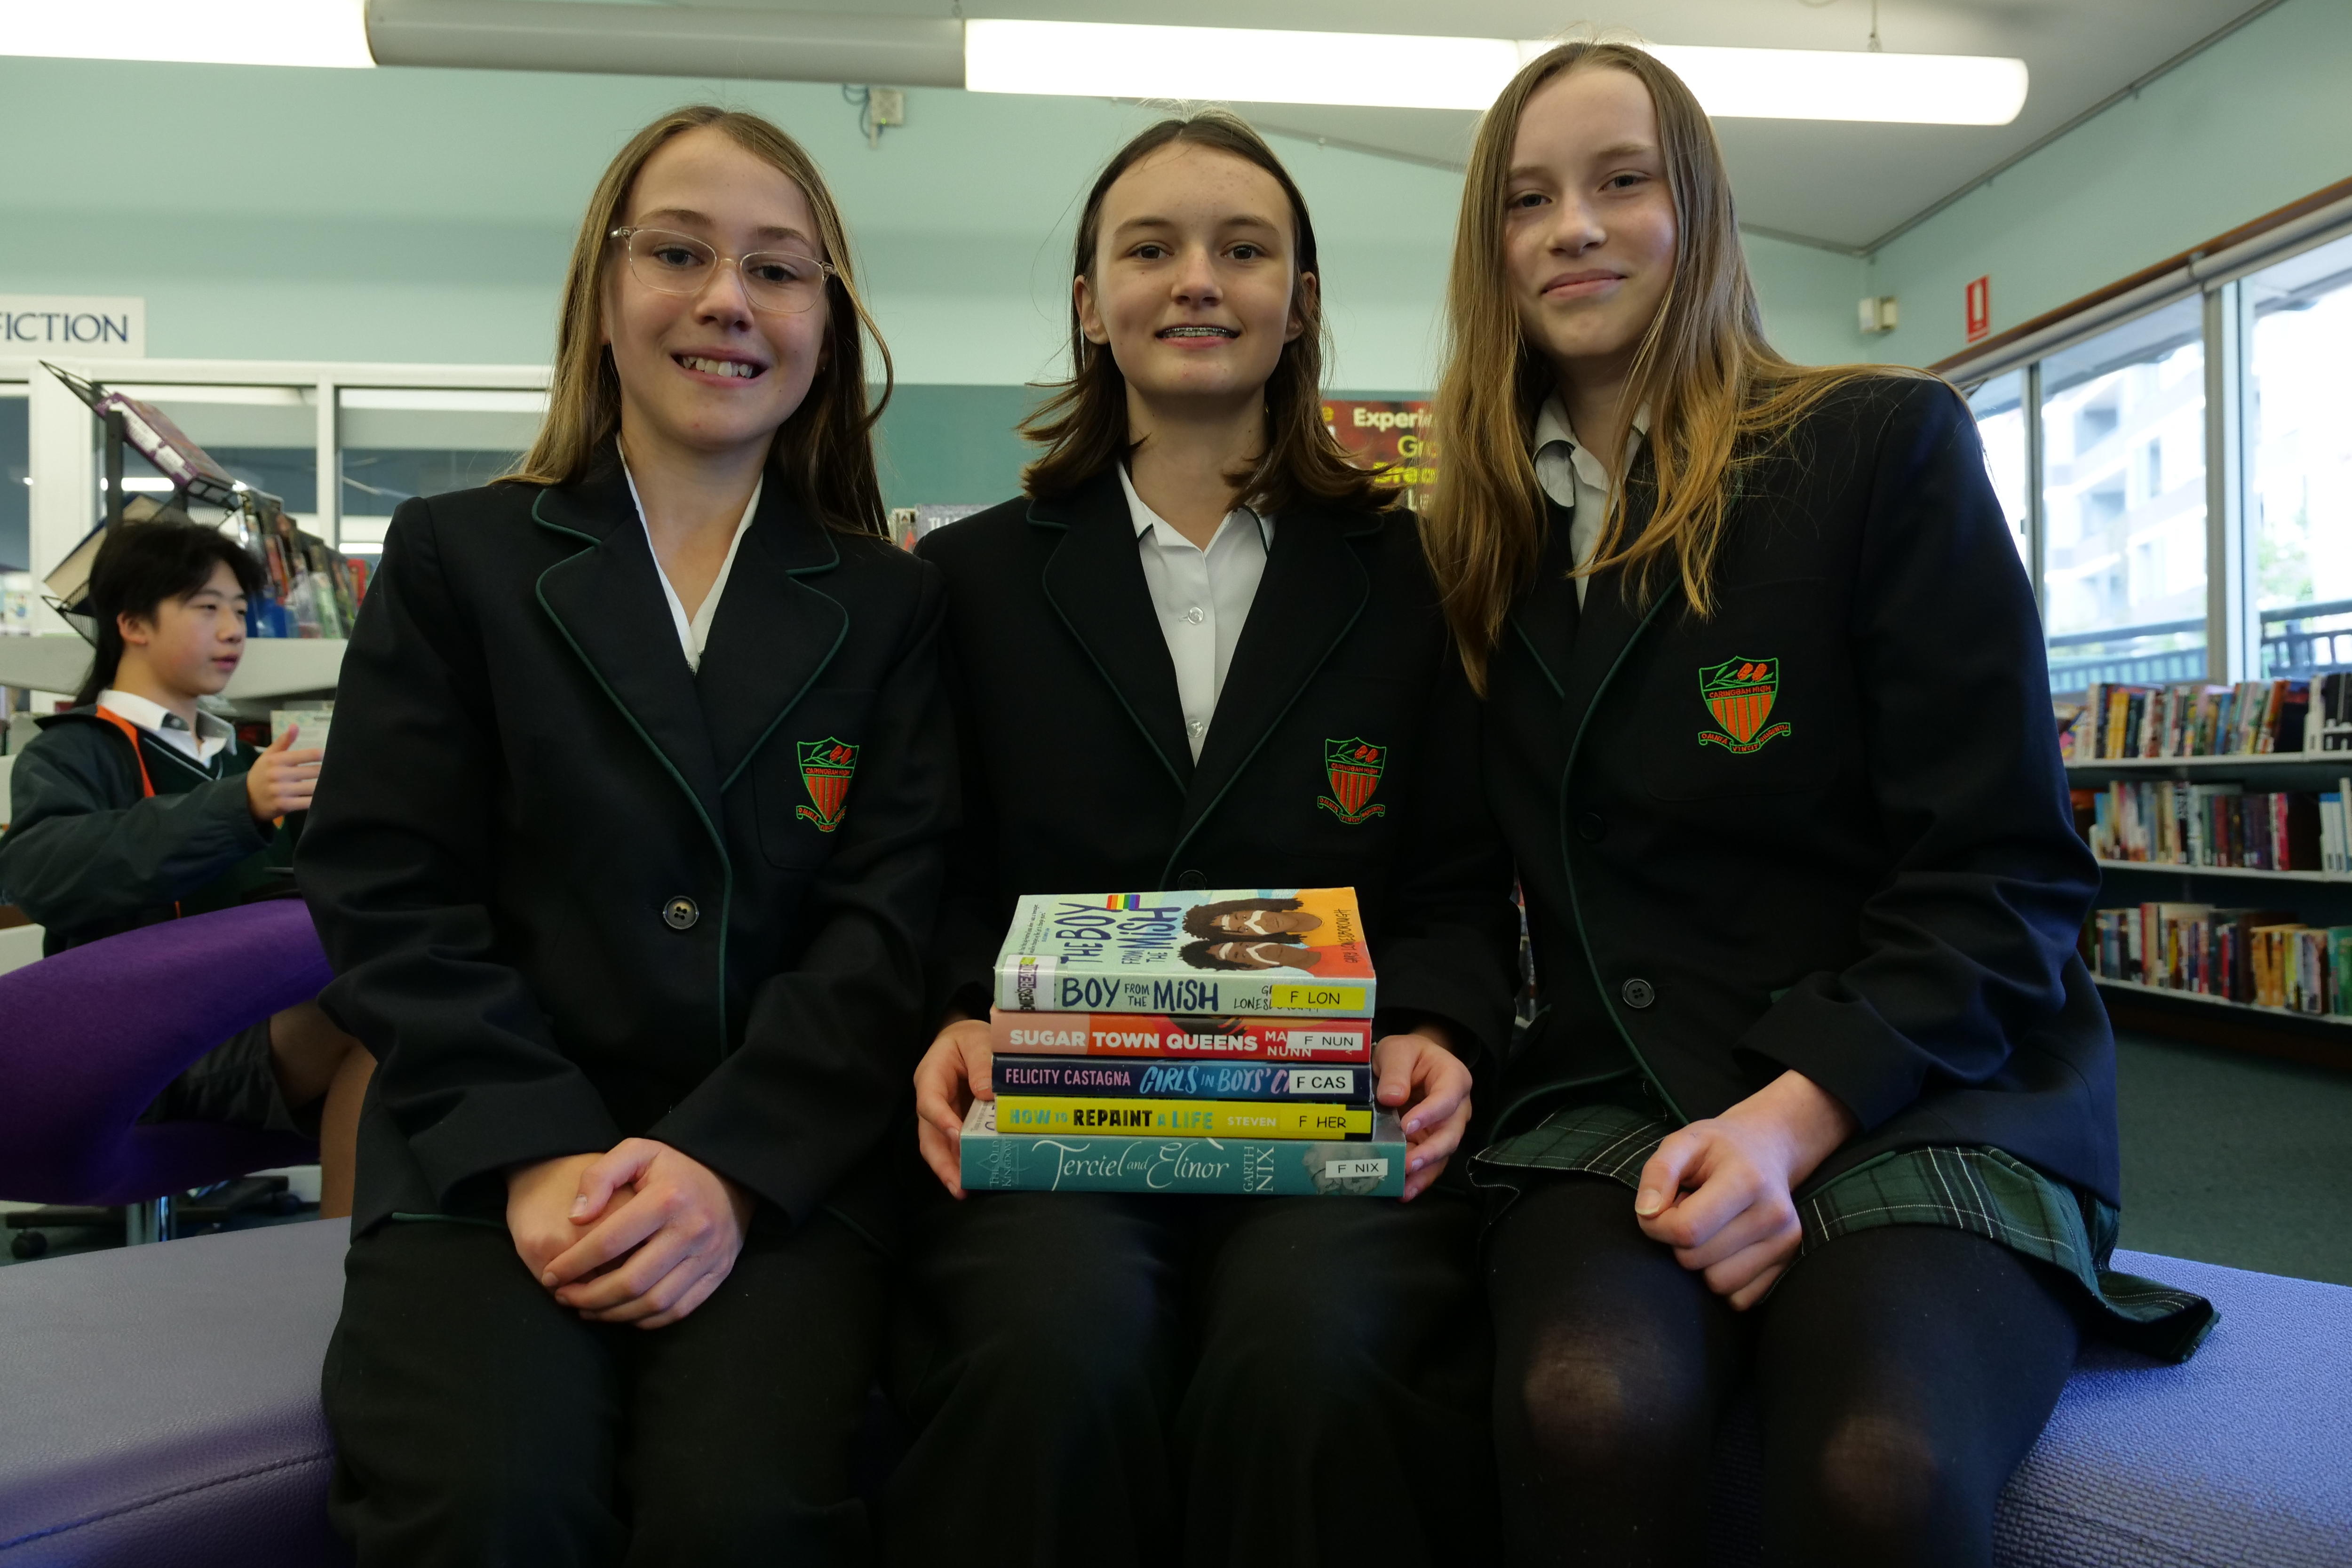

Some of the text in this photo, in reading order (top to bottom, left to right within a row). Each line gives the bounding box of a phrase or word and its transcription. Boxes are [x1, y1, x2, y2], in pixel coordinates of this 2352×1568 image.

[1708, 685, 1772, 699] CARINGBAH HIGH
[1701, 733, 1729, 745] OMNIA
[1732, 744, 1759, 752] VINCIT
[1331, 763, 1363, 773] CARINGBAH
[1054, 902, 1123, 964] THE BOY
[1333, 908, 1357, 950] LONESBOROUGH
[1121, 950, 1145, 964] FROM
[1146, 951, 1168, 963] THE
[1062, 977, 1120, 1008] BOY
[1124, 984, 1150, 995] FROM
[1127, 995, 1147, 1007] THE
[1290, 991, 1299, 1003] F
[1308, 992, 1340, 1005] LON
[1009, 1029, 1086, 1047] SUGAR
[1092, 1031, 1160, 1048] TOWN
[1166, 1033, 1258, 1051] QUEENS
[1304, 1035, 1353, 1046] F NUN
[1267, 1046, 1312, 1057] NUNN
[1005, 1068, 1060, 1084] FELICITY
[1064, 1069, 1131, 1086] CASTAGNA
[1139, 1066, 1200, 1094] GIRLS
[1200, 1073, 1215, 1087] IN
[1296, 1076, 1306, 1089] F
[1311, 1076, 1346, 1089] CAS
[1009, 1109, 1051, 1124] HOW
[1073, 1109, 1152, 1127] REPAINT
[1157, 1113, 1166, 1126] A
[1171, 1110, 1213, 1130] LIFE
[1227, 1116, 1277, 1127] STEVEN
[1299, 1115, 1346, 1128] F HER
[1031, 1139, 1229, 1192] Terciel and Elinor
[1243, 1146, 1254, 1192] GARTH
[1256, 1146, 1274, 1192] NIX
[1338, 1163, 1379, 1173] F NIX
